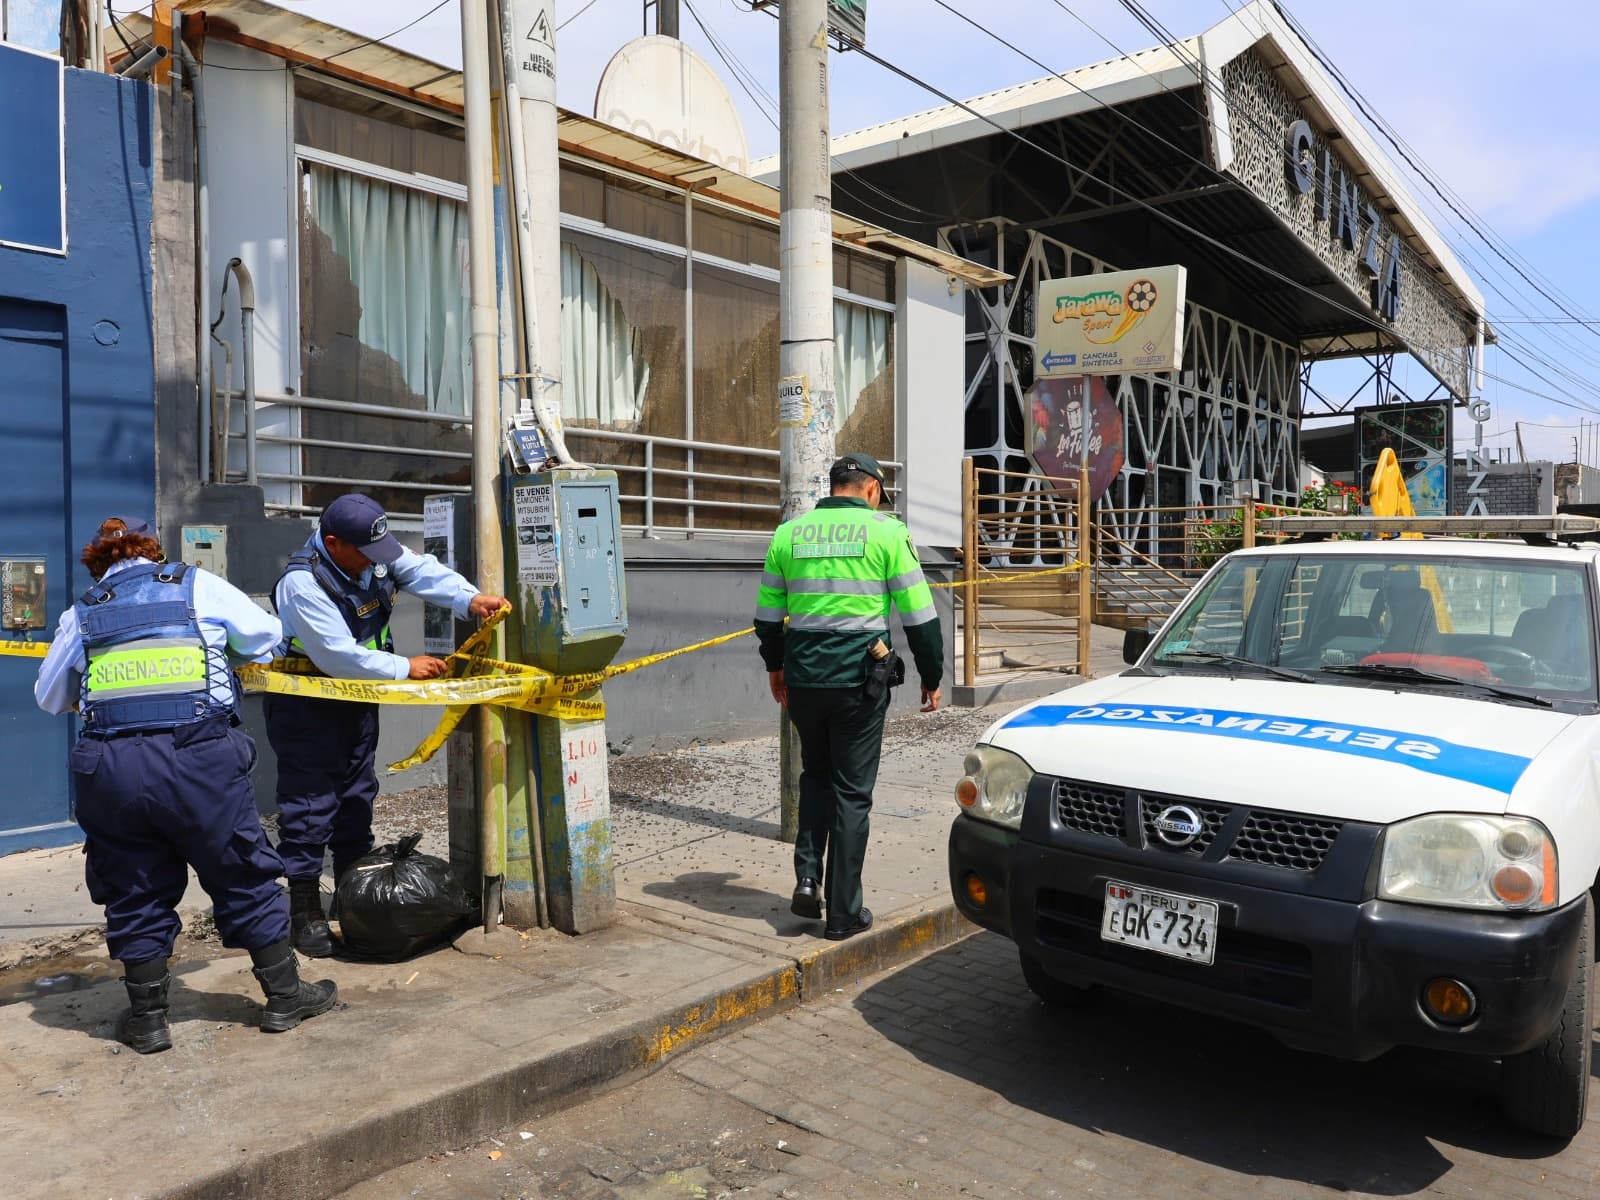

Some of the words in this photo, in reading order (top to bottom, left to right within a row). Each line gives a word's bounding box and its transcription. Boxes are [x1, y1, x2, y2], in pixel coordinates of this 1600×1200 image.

[1286, 119, 1401, 298] GINZA
[1082, 351, 1118, 360] CANCHAS
[1465, 399, 1491, 516] GINZA
[515, 488, 525, 497] SE
[526, 486, 550, 496] VENDE
[516, 495, 550, 504] CAMIONETA
[517, 505, 550, 514] MITSUBISHI
[791, 523, 868, 545] POLICIA
[96, 656, 195, 684] SERENAZGO
[306, 675, 389, 696] PELIGRO
[321, 686, 337, 696] NO
[341, 690, 380, 700] PASAR
[560, 698, 573, 708] NO
[574, 700, 602, 711] PASAR
[1157, 820, 1195, 833] NISSAN
[1140, 893, 1179, 911] PERU
[1110, 902, 1208, 954] EGK-734
